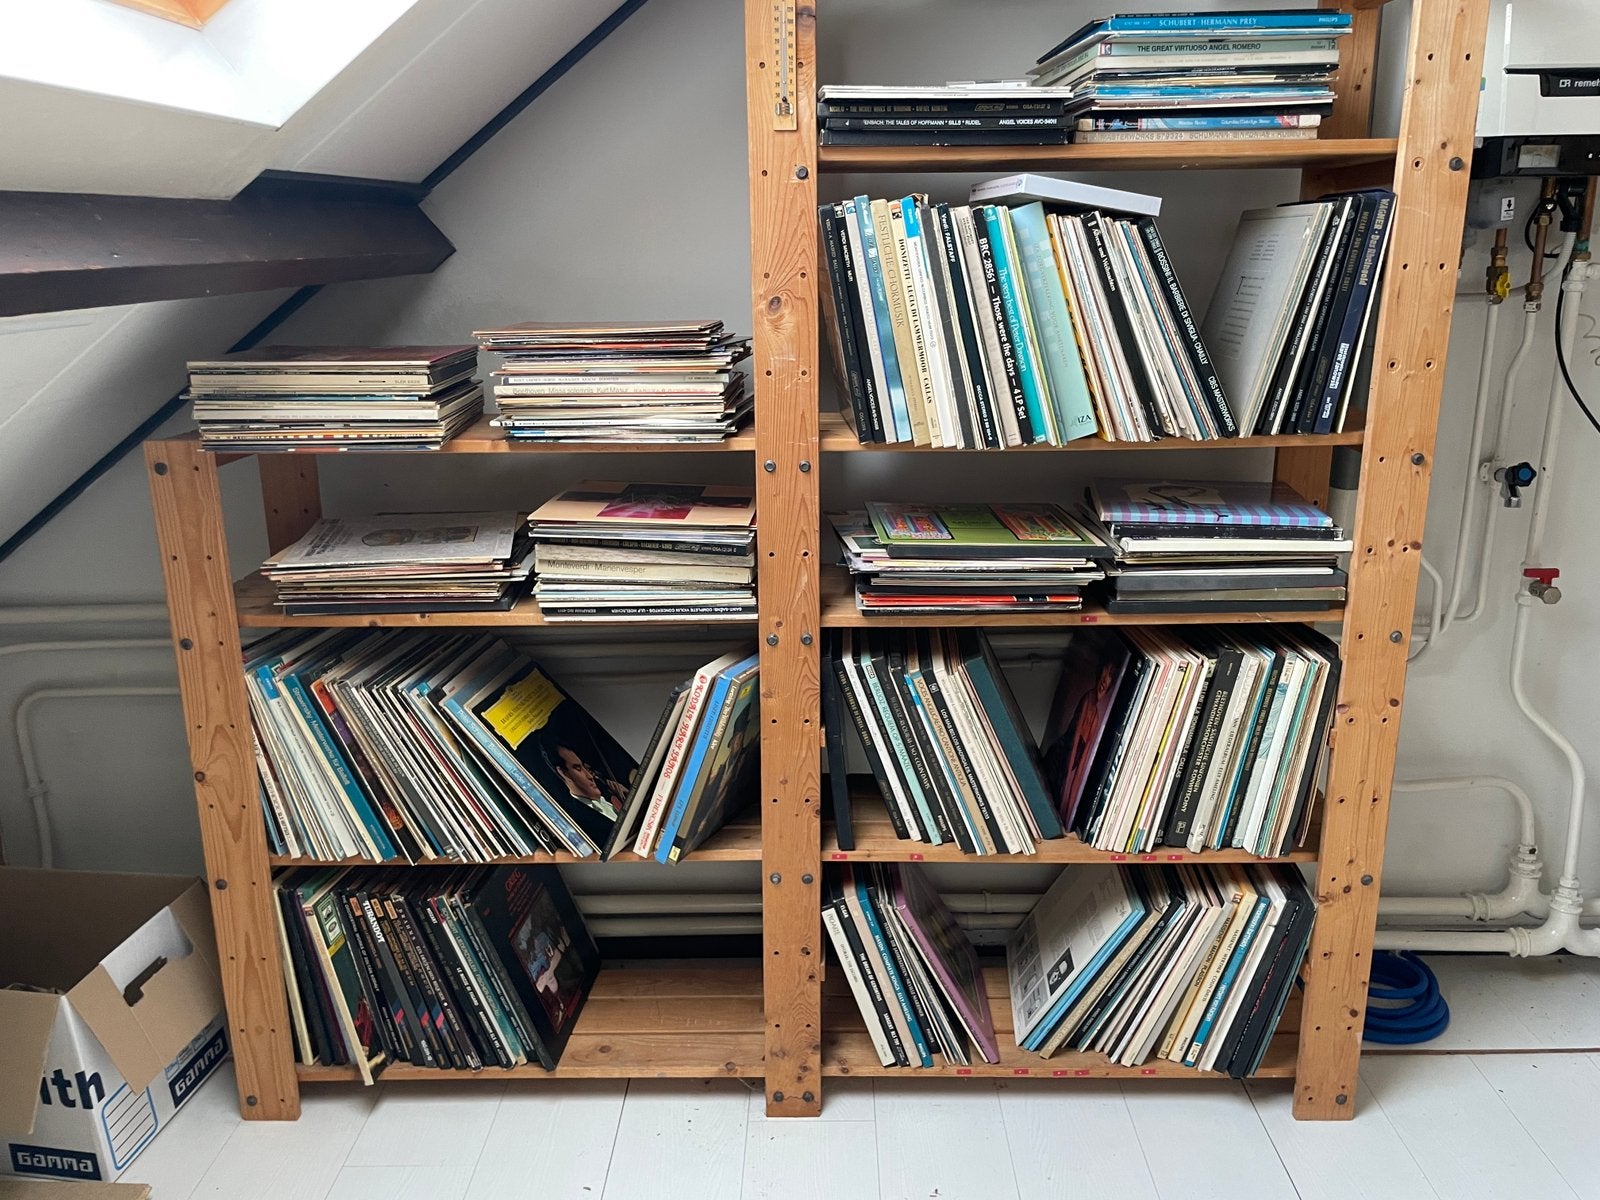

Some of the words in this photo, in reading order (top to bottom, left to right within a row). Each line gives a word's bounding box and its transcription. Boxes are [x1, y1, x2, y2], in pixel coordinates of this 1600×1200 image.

[1373, 196, 1390, 230] WAGNER
[940, 213, 948, 229] Verdi
[944, 232, 955, 262] FALSTAFF
[978, 237, 990, 258] BRC
[897, 238, 910, 279] DONIZETTI
[1097, 246, 1105, 258] und
[877, 214, 894, 267] FESTLICHE
[886, 268, 905, 327] CHORMUSIK
[982, 257, 995, 283] 28561
[998, 267, 1008, 281] The
[1155, 251, 1172, 278] ROSSINI:
[1357, 247, 1376, 286] Rheingold
[998, 280, 1011, 300] very
[1166, 276, 1175, 284] IL
[905, 285, 915, 307] LUCIA
[1168, 282, 1186, 310] BARBIERE
[910, 308, 917, 318] DI
[991, 296, 1004, 321] Those
[1005, 299, 1015, 314] best
[1180, 310, 1189, 318] DI
[1008, 313, 1017, 323] of
[996, 321, 1007, 342] were
[1010, 323, 1022, 342] Peter
[1183, 316, 1198, 341] SIVIGLIA
[912, 318, 927, 373] LAMMERMOOR
[1001, 342, 1012, 357] the
[1193, 341, 1208, 365] CHAILLY
[1003, 356, 1017, 377] days
[1014, 341, 1028, 372] Dawson
[922, 376, 932, 404] CALLAS
[1207, 375, 1218, 389] CBS
[1014, 394, 1023, 405] LP
[1212, 387, 1236, 431] MASTERWORKS
[1016, 405, 1026, 419] Set
[1077, 415, 1092, 424] IZA
[547, 560, 590, 570] Monteverdi
[594, 563, 645, 574] Marienvesper
[916, 678, 928, 697] VOCES
[1194, 705, 1200, 714] LA
[1212, 690, 1227, 725] BEETHOVEN
[1194, 689, 1222, 766] GEWANDHAUSORCHESTER
[940, 708, 948, 719] LOS
[966, 772, 984, 807] MASTERWORKS
[1175, 756, 1185, 778] CALLAS
[1180, 768, 1198, 813] KONWITSCHNY
[425, 907, 437, 924] MOZART
[839, 904, 848, 918] ELGAR
[361, 899, 385, 944] TURANDOT
[1214, 916, 1230, 942] MASSENET
[874, 934, 884, 951] HAYDN
[858, 952, 866, 961] THE
[881, 952, 894, 975] COMPLETE
[1205, 944, 1217, 963] MANON
[861, 960, 871, 974] DREAM
[1193, 964, 1207, 987] PLASSON
[869, 979, 882, 1002] GERONTIUS
[890, 974, 900, 991] SONGS
[896, 991, 905, 1003] ELLY
[882, 1012, 893, 1030] SARGENT
[900, 1002, 912, 1022] AMELING
[925, 1027, 934, 1043] PHILIPS
[917, 1042, 927, 1058] PHILIPS
